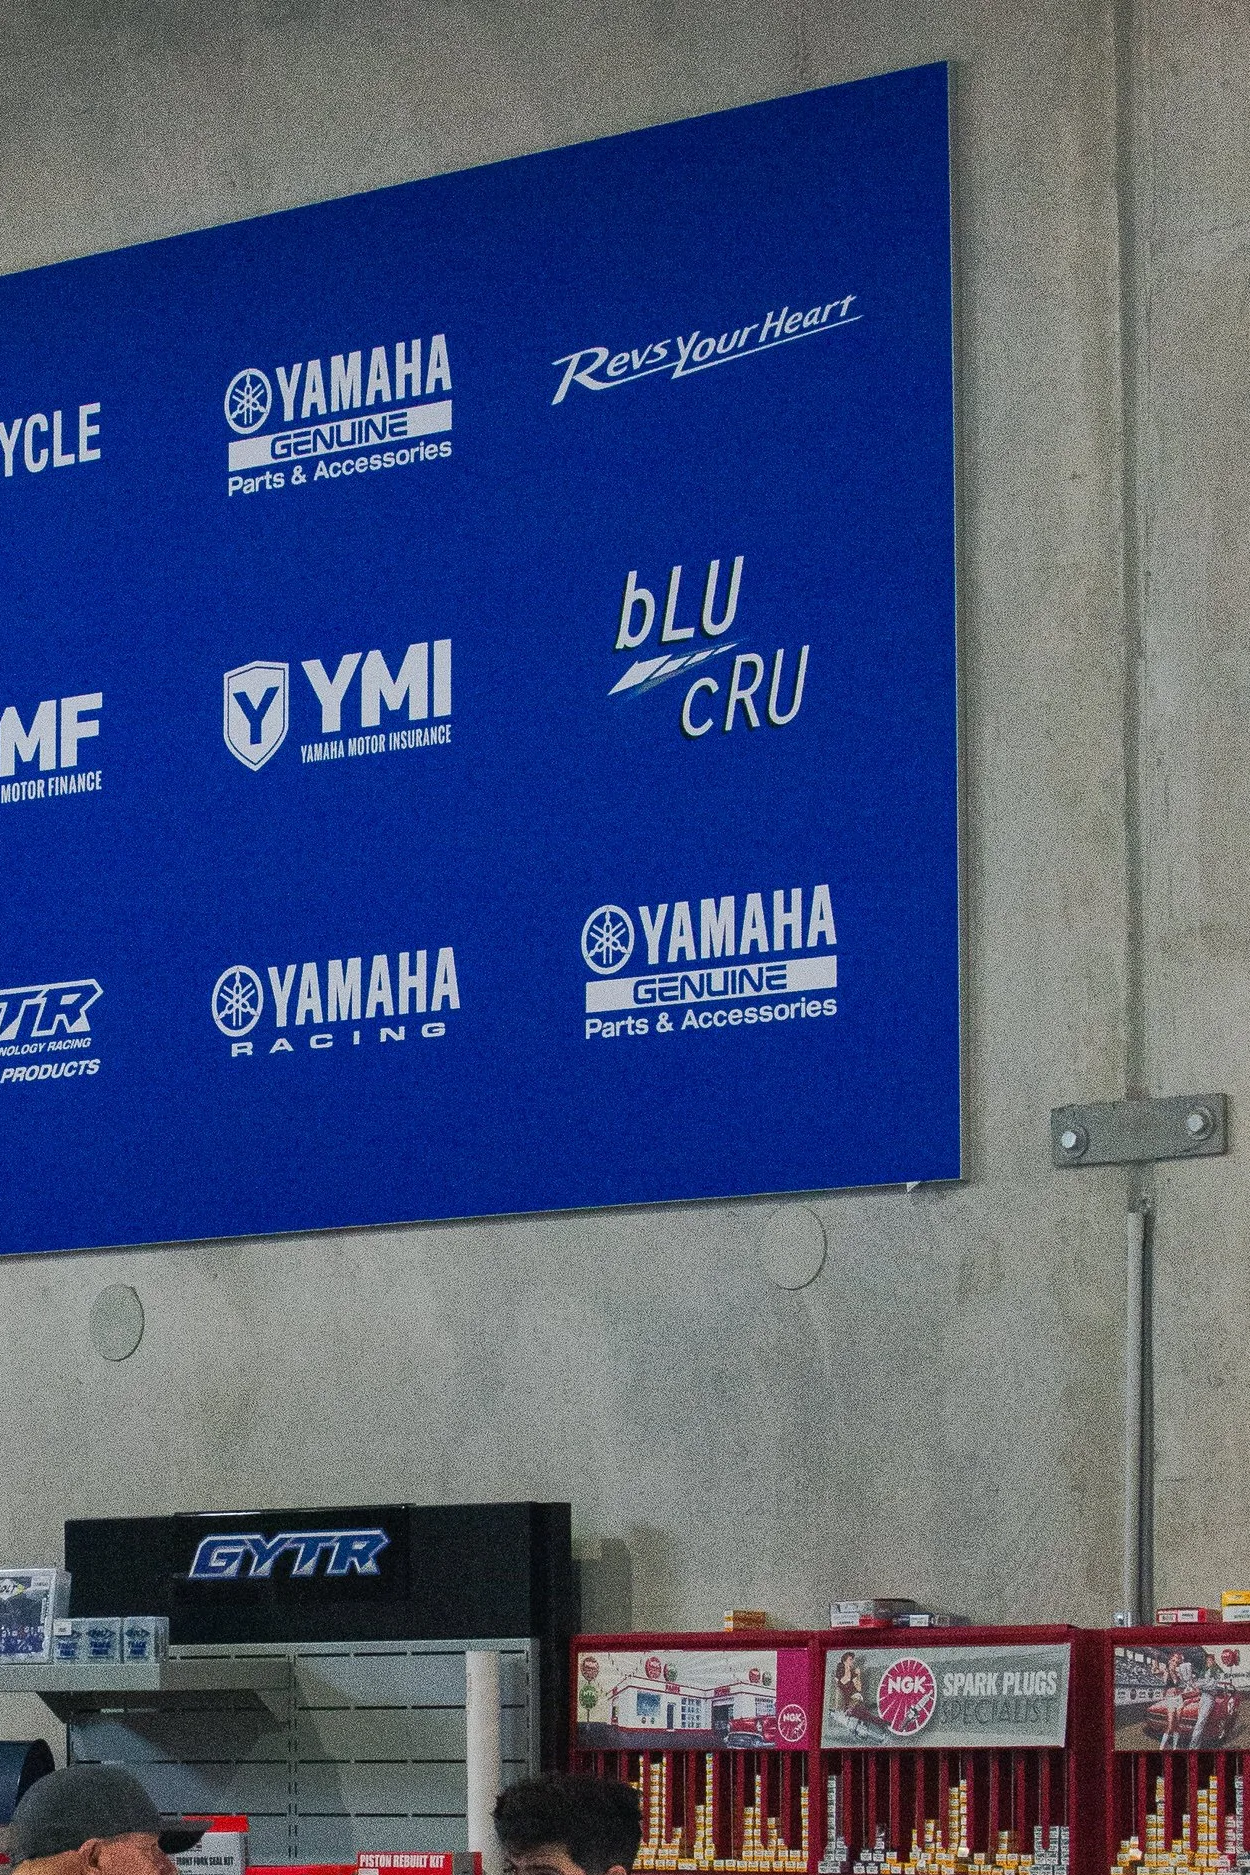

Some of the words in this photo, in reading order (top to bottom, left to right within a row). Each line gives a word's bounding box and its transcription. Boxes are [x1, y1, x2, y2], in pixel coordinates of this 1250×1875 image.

[550, 338, 670, 406] Revs
[671, 322, 759, 378] Your
[759, 294, 858, 347] Heart
[275, 333, 452, 422] YAMAHA
[271, 412, 408, 460] GENUINE
[228, 471, 285, 497] Parts
[290, 464, 307, 485] &
[313, 440, 453, 481] Accessories
[615, 555, 745, 649] bLU
[301, 638, 452, 734] YMI
[300, 740, 345, 763] YAMAHA
[347, 733, 386, 756] MOTOR
[388, 724, 451, 751] INSURANCE
[0, 778, 45, 804] MOTOR
[47, 770, 102, 797] FINANCE
[638, 883, 837, 965] YAMAHA
[267, 946, 461, 1028] YAMAHA
[634, 964, 787, 1004] GENUINE
[585, 1015, 649, 1040] Parts
[655, 1011, 674, 1033] &
[681, 996, 838, 1030] Accessories
[47, 1037, 92, 1051] RACING
[231, 1022, 446, 1058] RACING
[0, 1058, 101, 1084] PRODUCTS
[188, 1527, 392, 1581] GYTR
[887, 1676, 927, 1694] NGK
[942, 1671, 1000, 1697] SPARK
[1002, 1670, 1058, 1696] PLUGS
[783, 1712, 802, 1723] NGK
[193, 1856, 209, 1866] FORK
[208, 1856, 223, 1866] SEAL
[223, 1856, 234, 1866] KIT
[359, 1854, 392, 1868] PISTON
[393, 1855, 428, 1868] REBUILT
[429, 1855, 445, 1868] KIT
